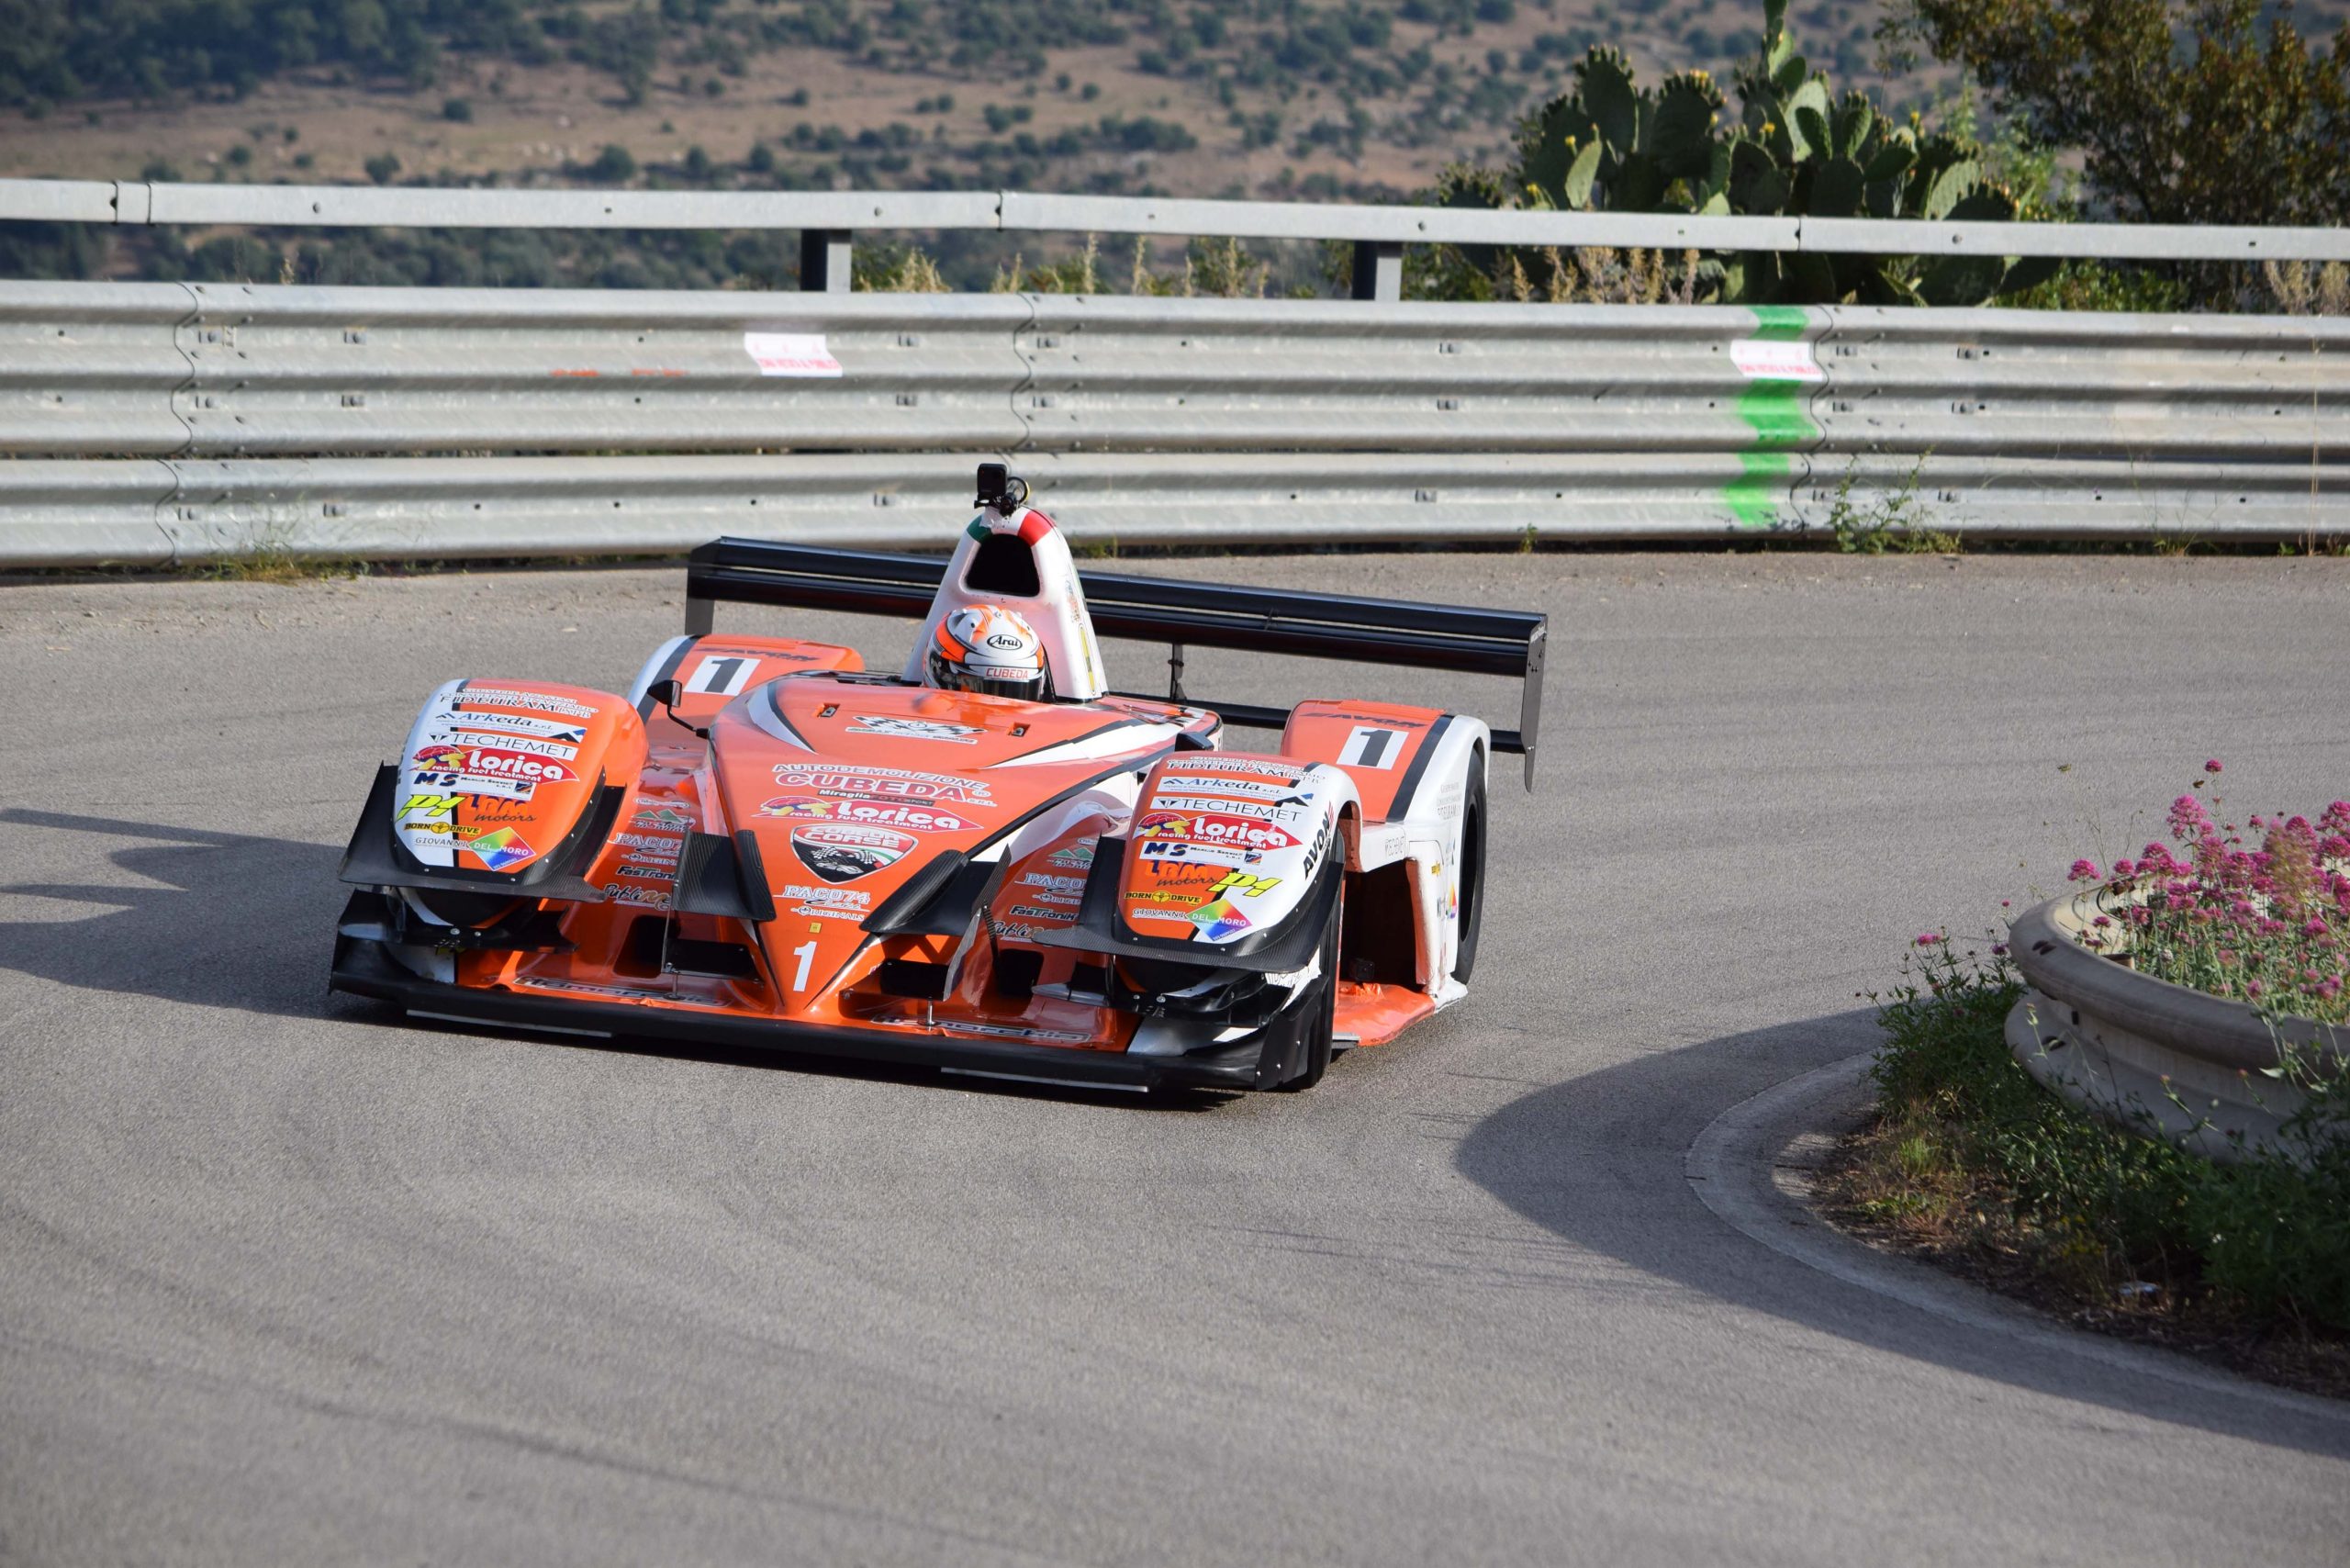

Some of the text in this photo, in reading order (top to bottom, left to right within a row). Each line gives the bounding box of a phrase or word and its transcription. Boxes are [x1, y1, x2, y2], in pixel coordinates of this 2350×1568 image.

[994, 635, 1019, 646] Arai
[705, 658, 744, 693] 1
[986, 667, 1028, 679] CUBEDA
[440, 695, 556, 712] FIDEURAM
[459, 712, 532, 727] Arkeda
[451, 732, 574, 757] TECHEMET
[1357, 729, 1393, 767] 1
[431, 765, 542, 783] racing fuel treatment
[774, 764, 990, 790] AUTODEMOLIZIONE
[1167, 762, 1283, 778] FIDEURAM
[776, 772, 968, 803] CUBEDA
[1184, 778, 1259, 790] Arkeda
[819, 789, 870, 800] Miraglia
[474, 812, 537, 823] motors
[1180, 798, 1302, 823] TECHEMET
[404, 822, 480, 835] BORN DRIVE
[789, 812, 933, 831] racing fuel treatment
[415, 836, 529, 857] GIOVANNI DEL MORO
[804, 833, 901, 848] CORSE
[1158, 832, 1267, 849] racing fuel treatment
[1304, 810, 1330, 879] AVON
[1157, 875, 1218, 887] motors
[783, 884, 871, 905] PACO74
[1125, 891, 1201, 903] BORN DRIVE
[1133, 908, 1247, 926] GIOVANNI DEL MORO
[792, 940, 818, 992] 1
